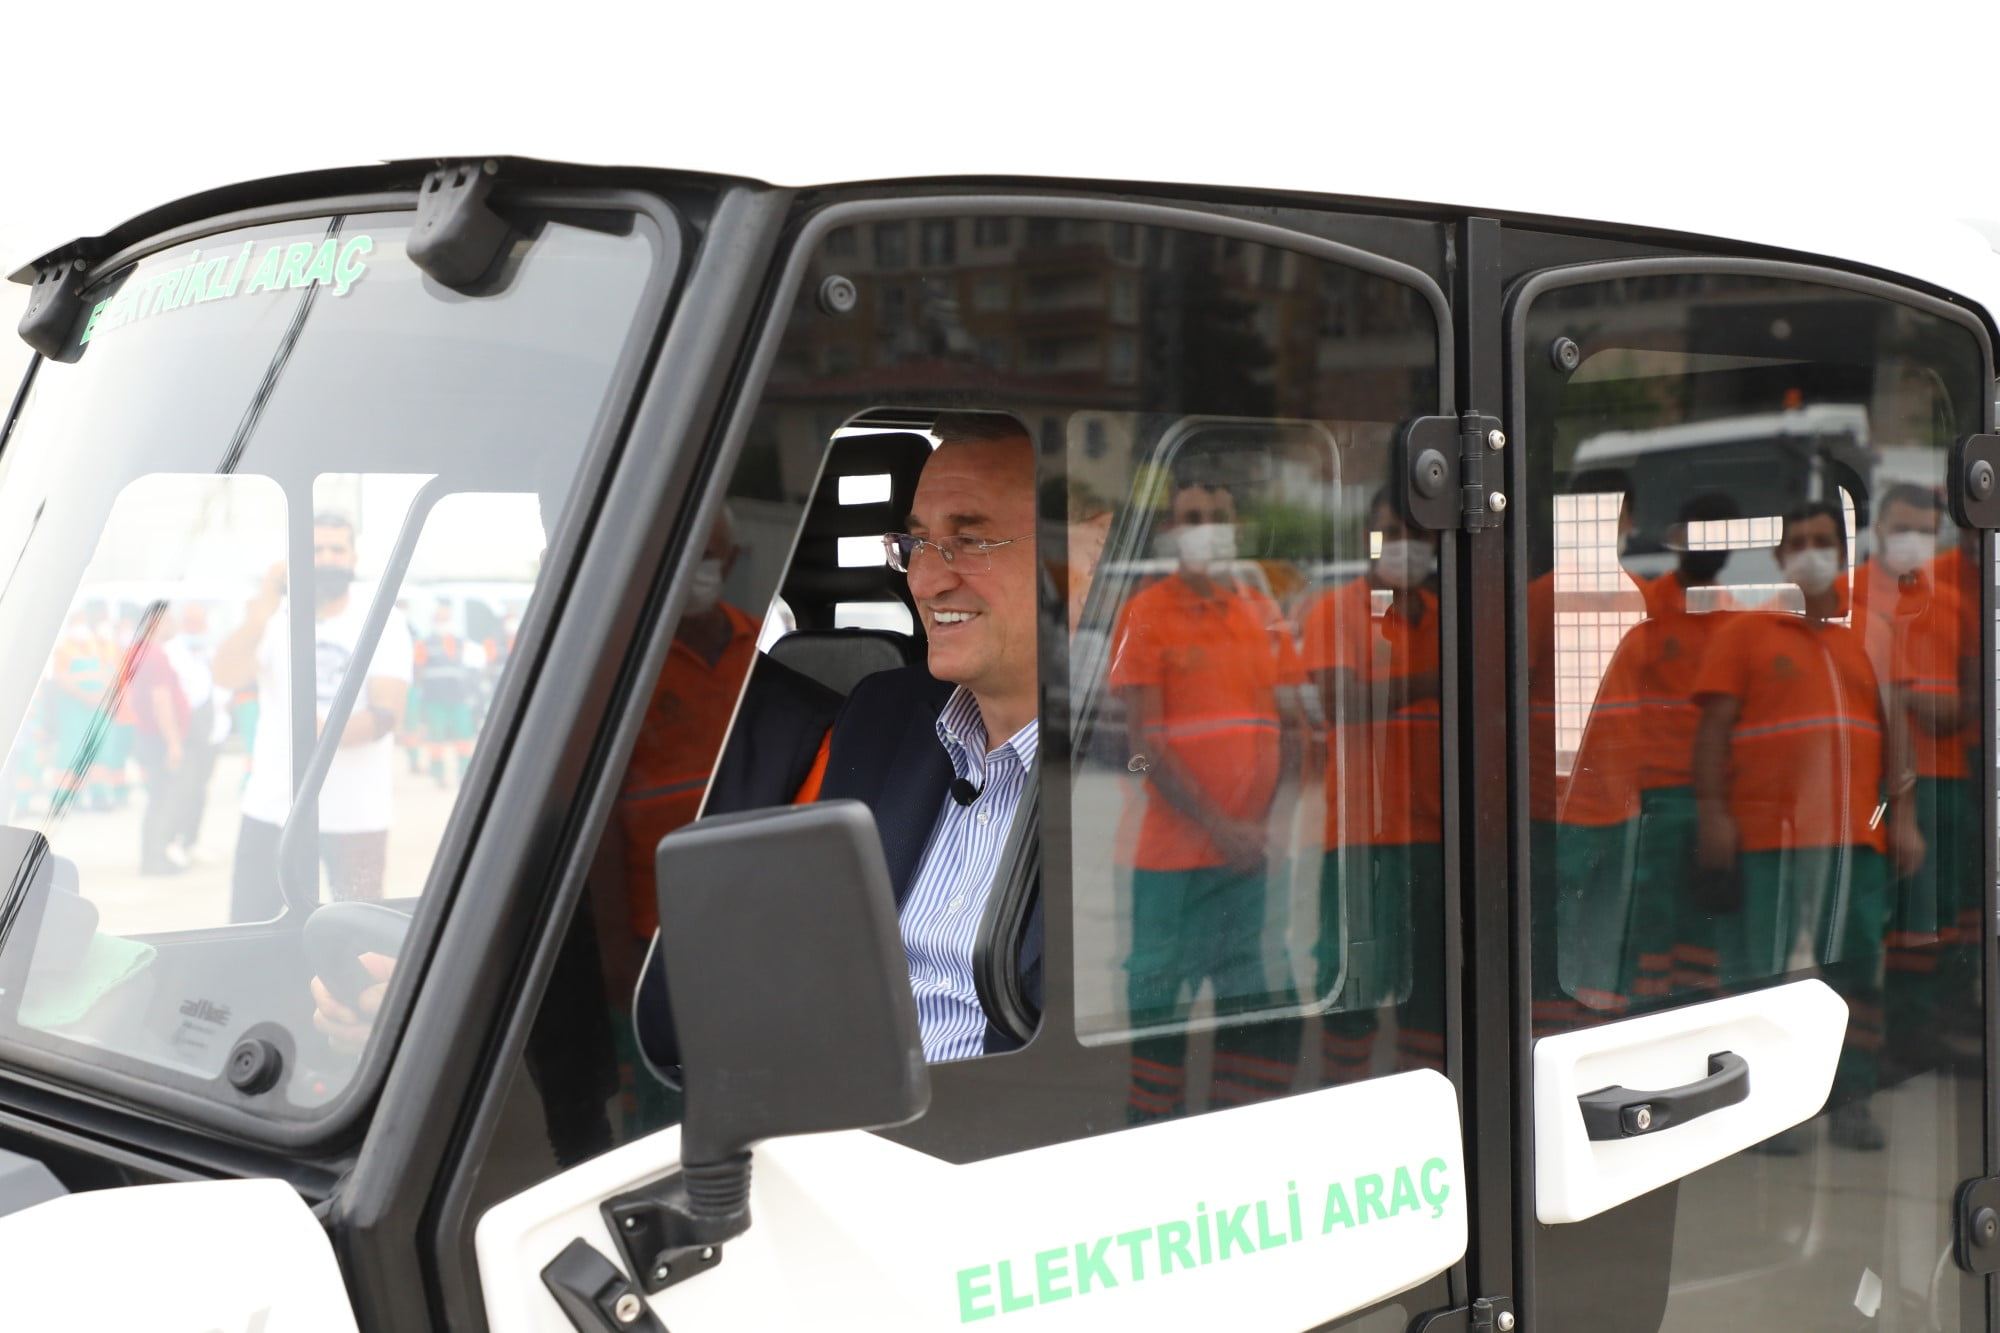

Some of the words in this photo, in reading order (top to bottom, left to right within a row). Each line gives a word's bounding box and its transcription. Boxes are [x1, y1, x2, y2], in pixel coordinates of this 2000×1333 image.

[80, 240, 254, 345] ELEKTRİKLİ
[246, 234, 374, 297] ARAÇ
[956, 1180, 1303, 1323] ELEKTRİKLİ
[1321, 1156, 1451, 1234] ARAÇ
